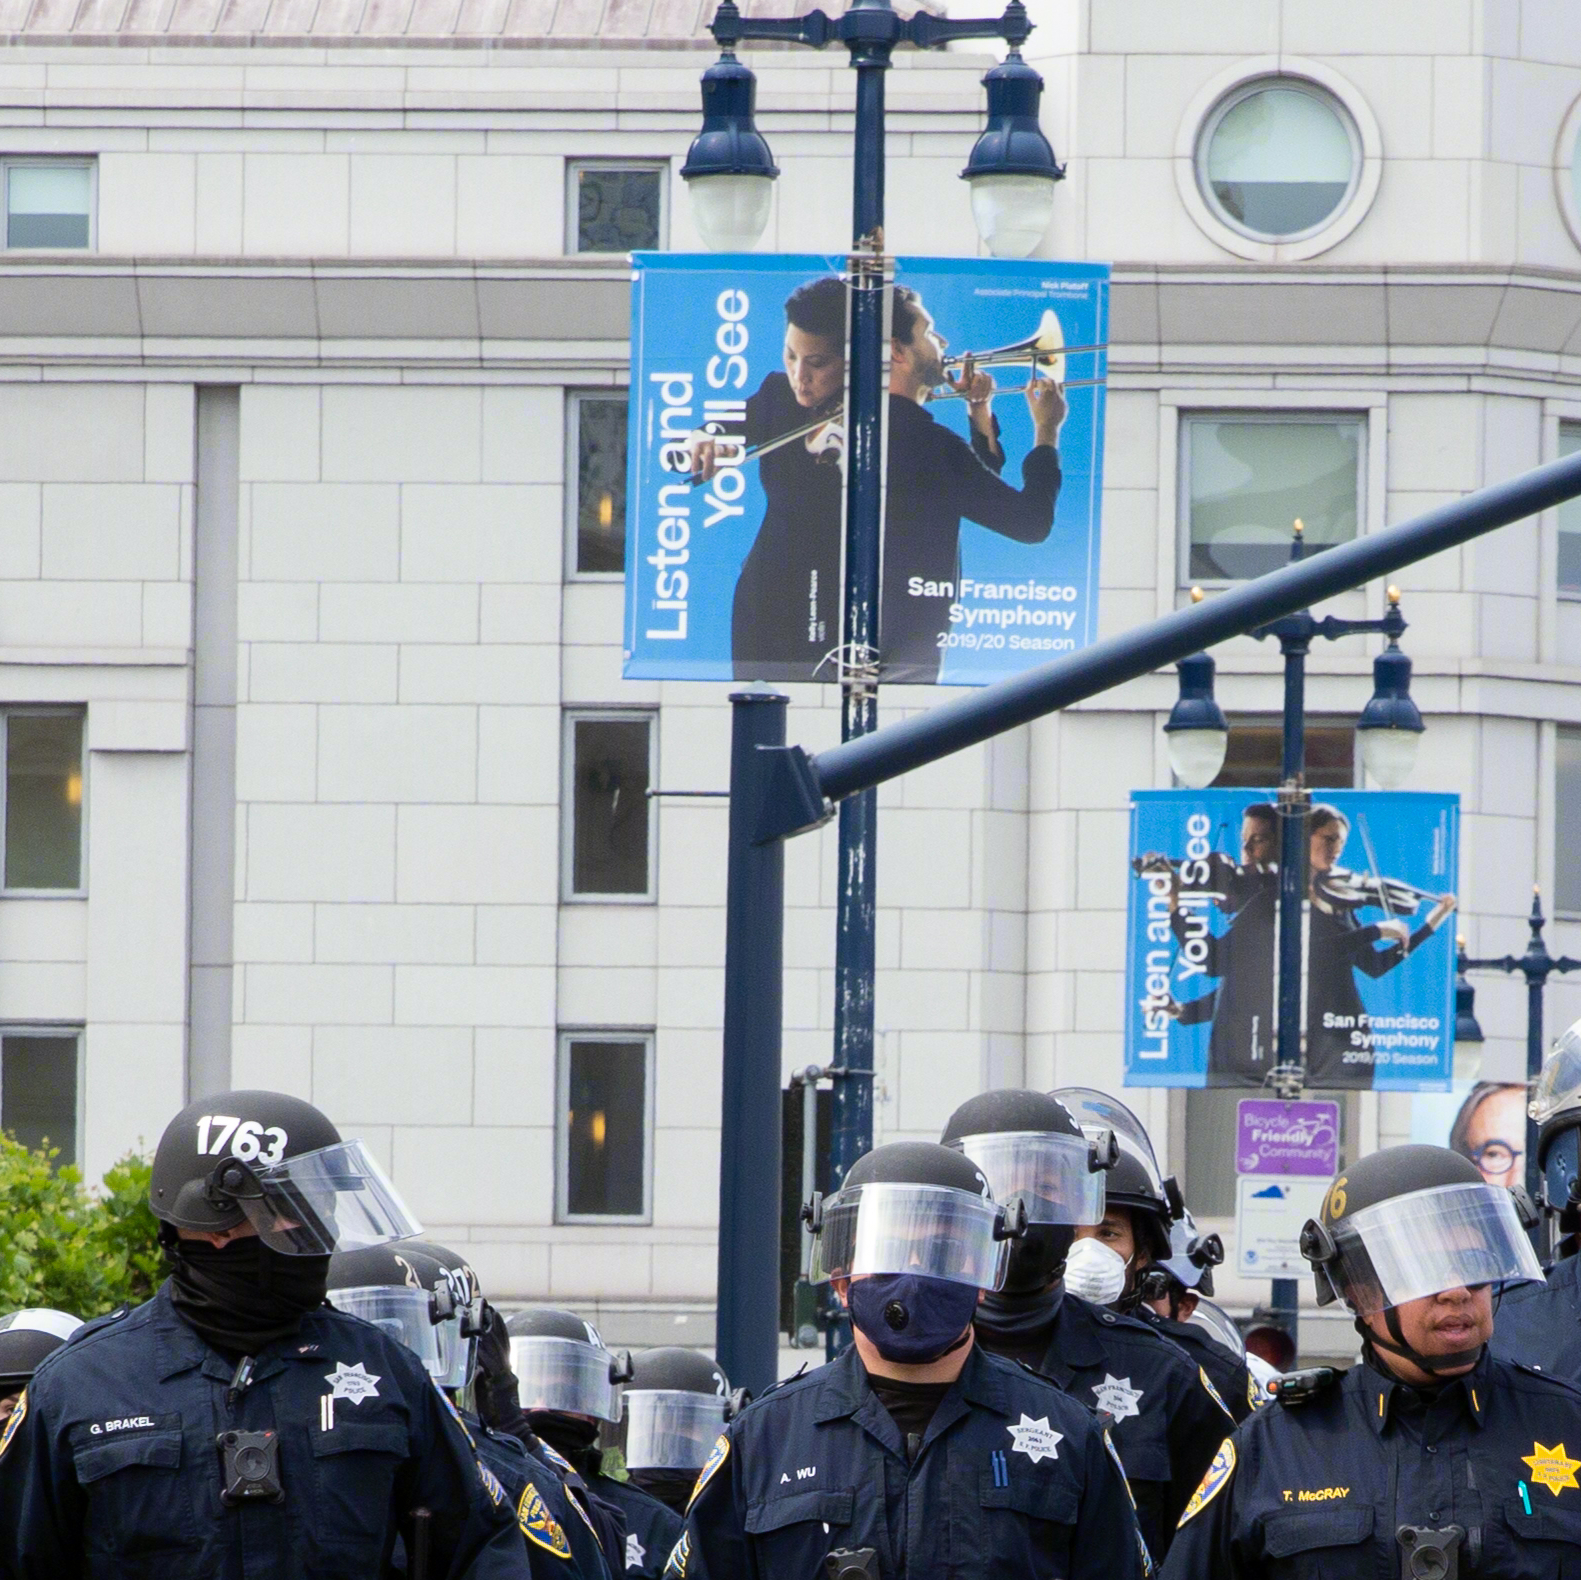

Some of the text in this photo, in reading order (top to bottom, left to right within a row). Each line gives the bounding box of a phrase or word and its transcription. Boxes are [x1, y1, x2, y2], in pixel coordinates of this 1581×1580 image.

[706, 289, 749, 389] See
[646, 372, 693, 639] Listen and
[907, 577, 1077, 602] San Francisco
[948, 603, 1076, 631] Symphony
[936, 632, 1075, 651] 2019/20 Season
[1180, 813, 1211, 885] See
[1139, 872, 1172, 1060] Listen and
[1323, 1012, 1439, 1030] San Francisco
[1350, 1030, 1439, 1051] Symphony
[1244, 1113, 1289, 1129] Bicycle
[195, 1115, 288, 1166] 1763
[1251, 1128, 1314, 1147] Friendly
[1258, 1143, 1333, 1162] Community
[90, 1416, 155, 1434] G. BRAKEL
[796, 1466, 816, 1481] WU
[1283, 1487, 1350, 1502] T. McCRAY
